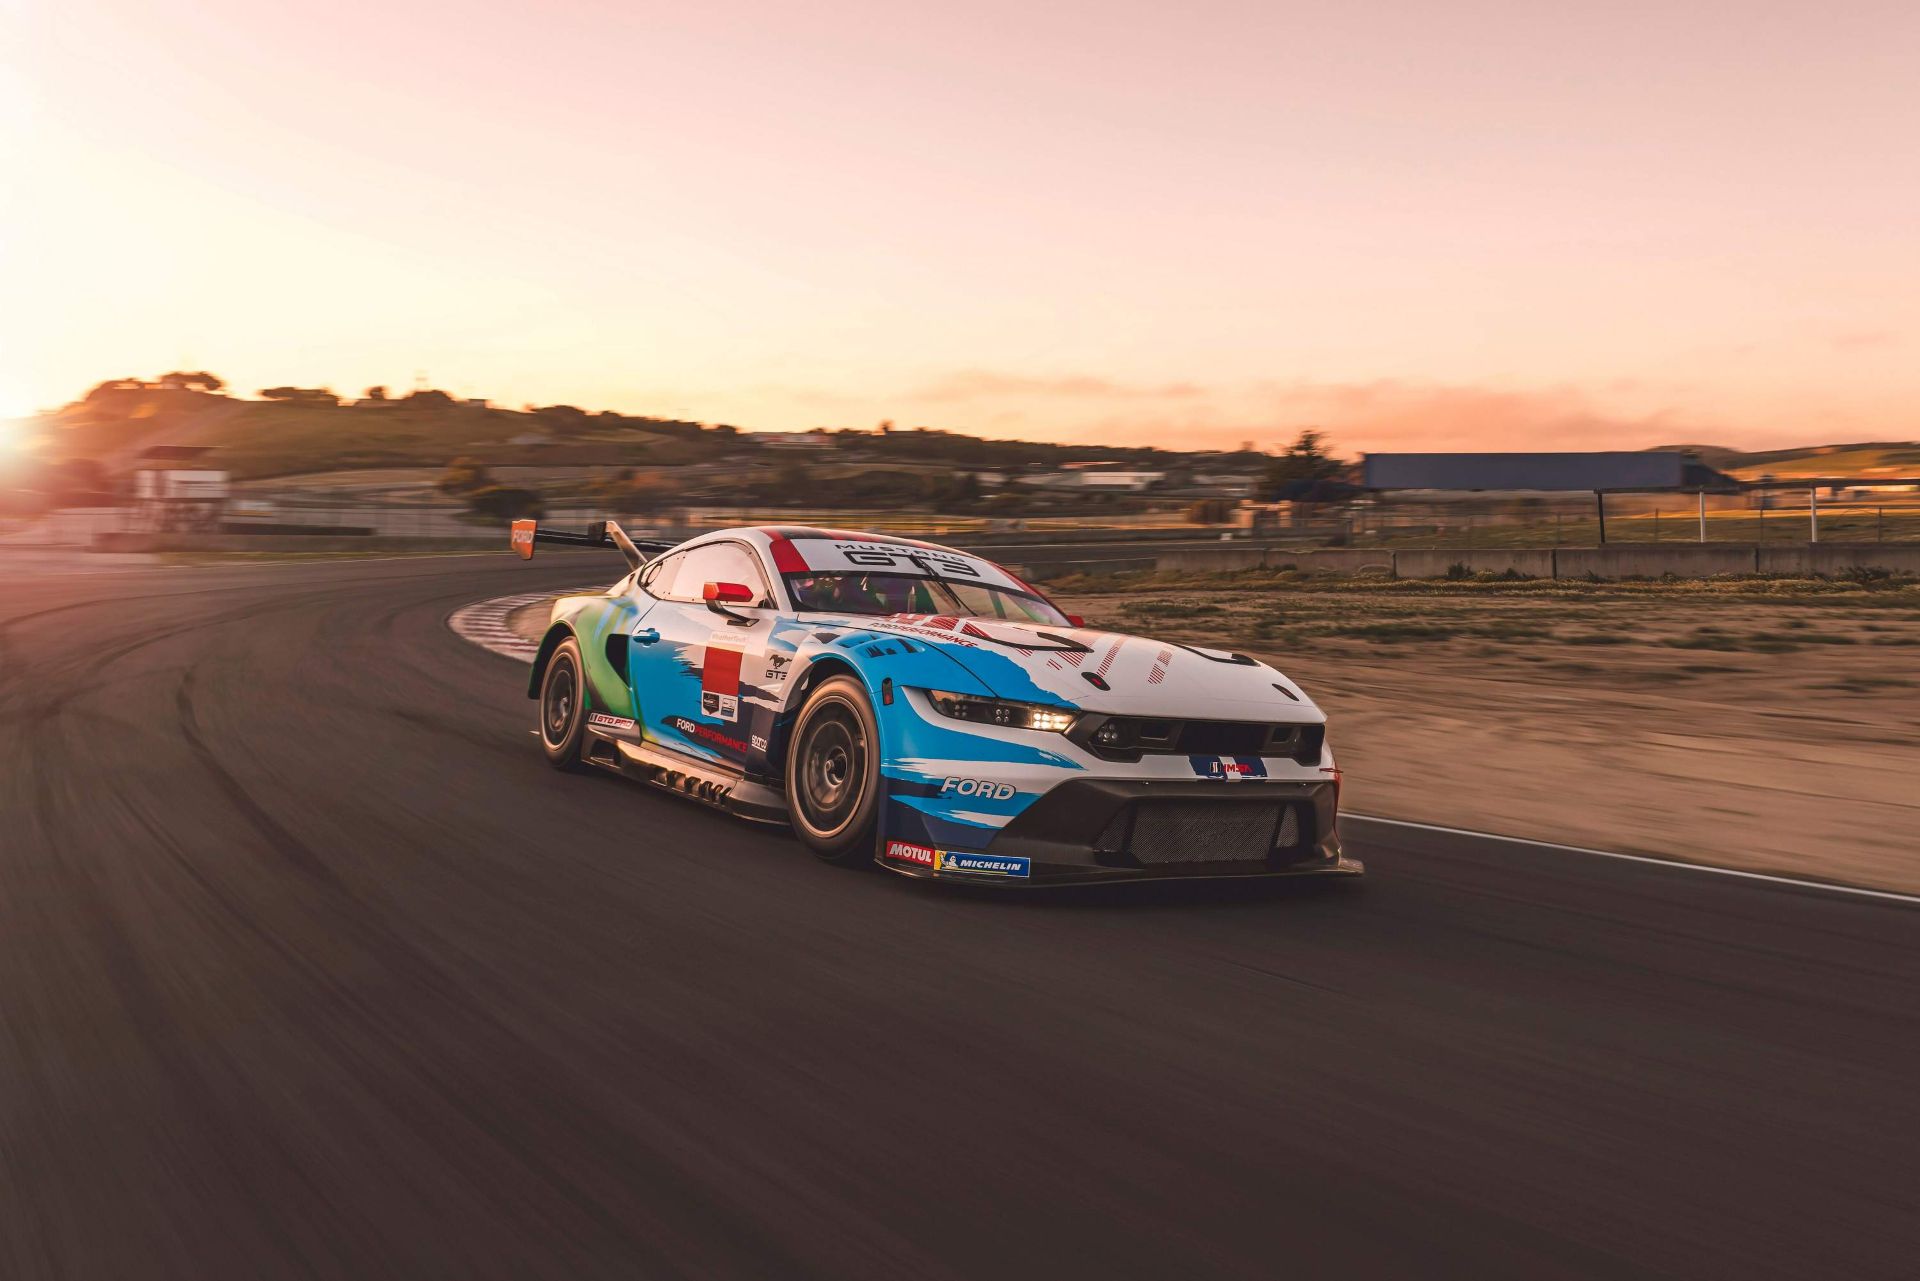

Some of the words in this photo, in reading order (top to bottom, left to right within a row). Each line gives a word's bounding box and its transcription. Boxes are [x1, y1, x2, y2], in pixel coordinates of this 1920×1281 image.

[512, 529, 535, 544] FORD
[835, 544, 965, 563] MUSTANG
[843, 551, 981, 577] GT3
[597, 715, 613, 724] GTD
[614, 719, 633, 727] PRO
[941, 776, 1016, 800] FORD
[890, 843, 932, 863] MOTUL
[960, 859, 1022, 871] MICHELIN
